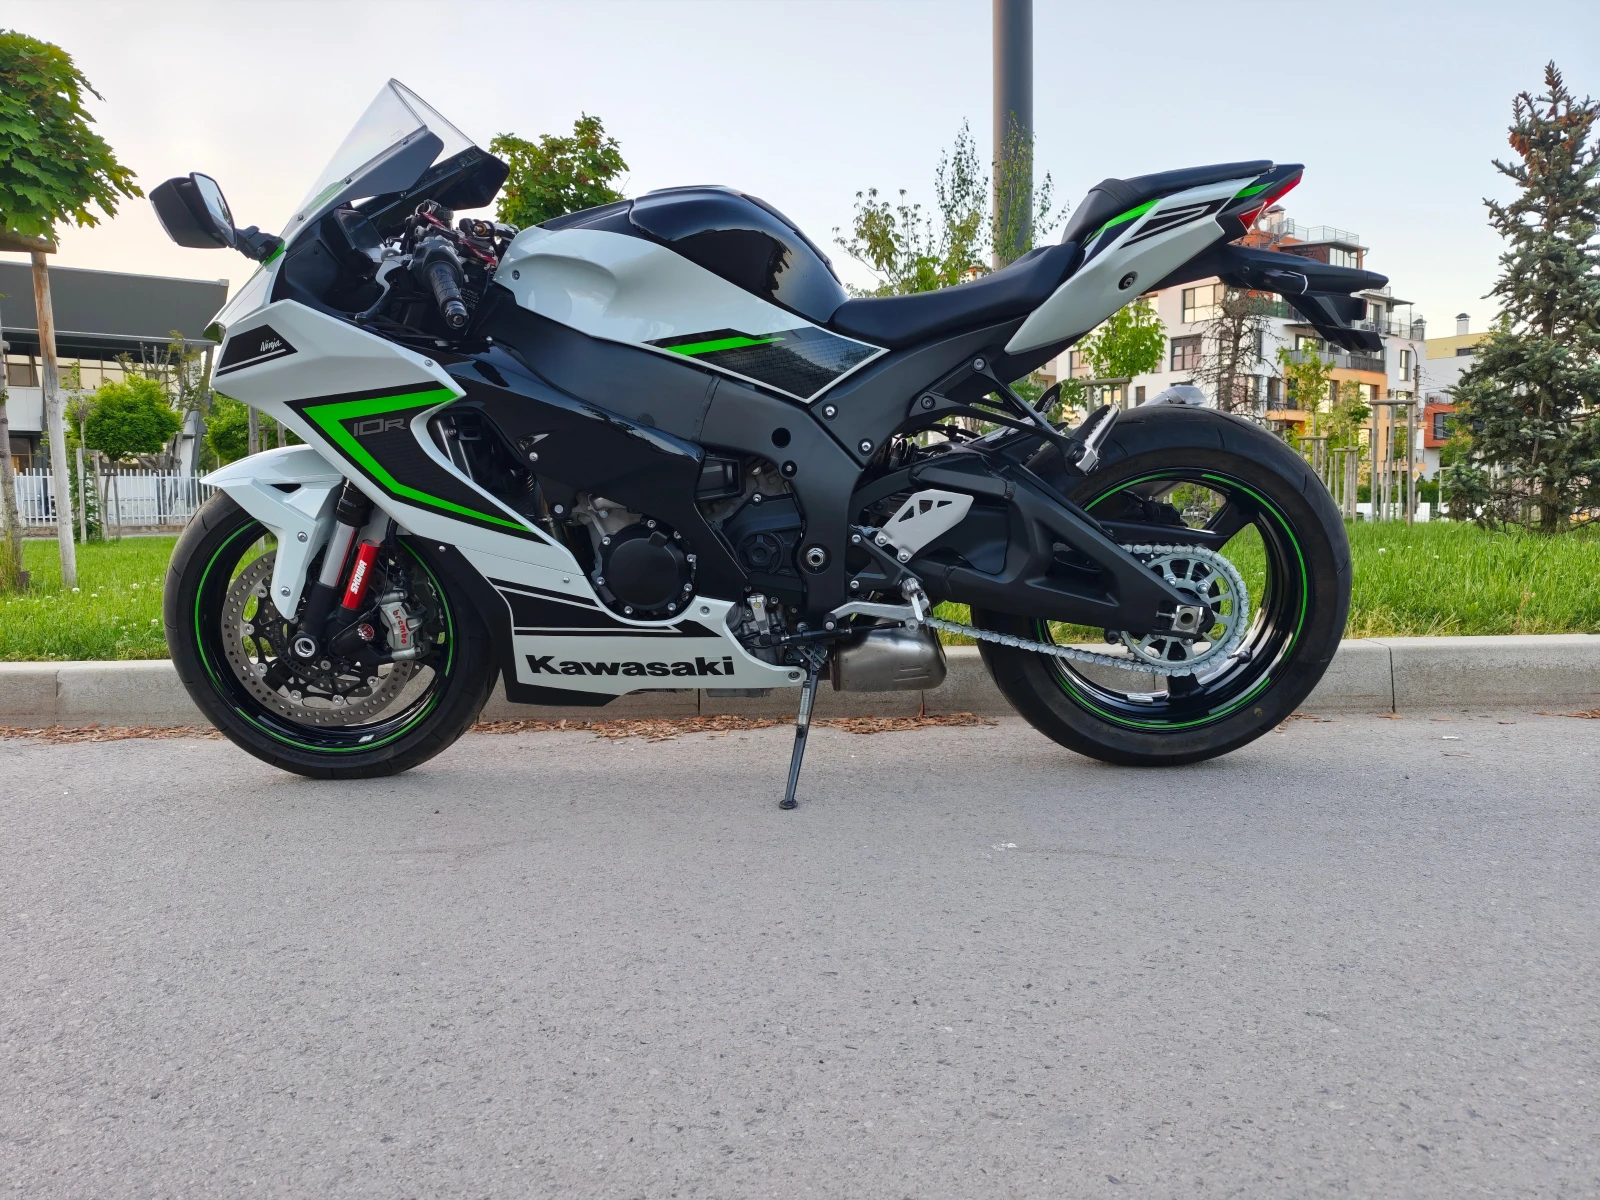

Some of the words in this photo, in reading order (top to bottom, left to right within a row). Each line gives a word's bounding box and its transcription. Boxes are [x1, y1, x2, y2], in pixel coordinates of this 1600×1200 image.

[260, 338, 282, 352] Ninja
[354, 418, 407, 437] 10R
[350, 559, 367, 595] SHOWA
[392, 609, 408, 644] brembo
[525, 654, 735, 677] Kawasaki
